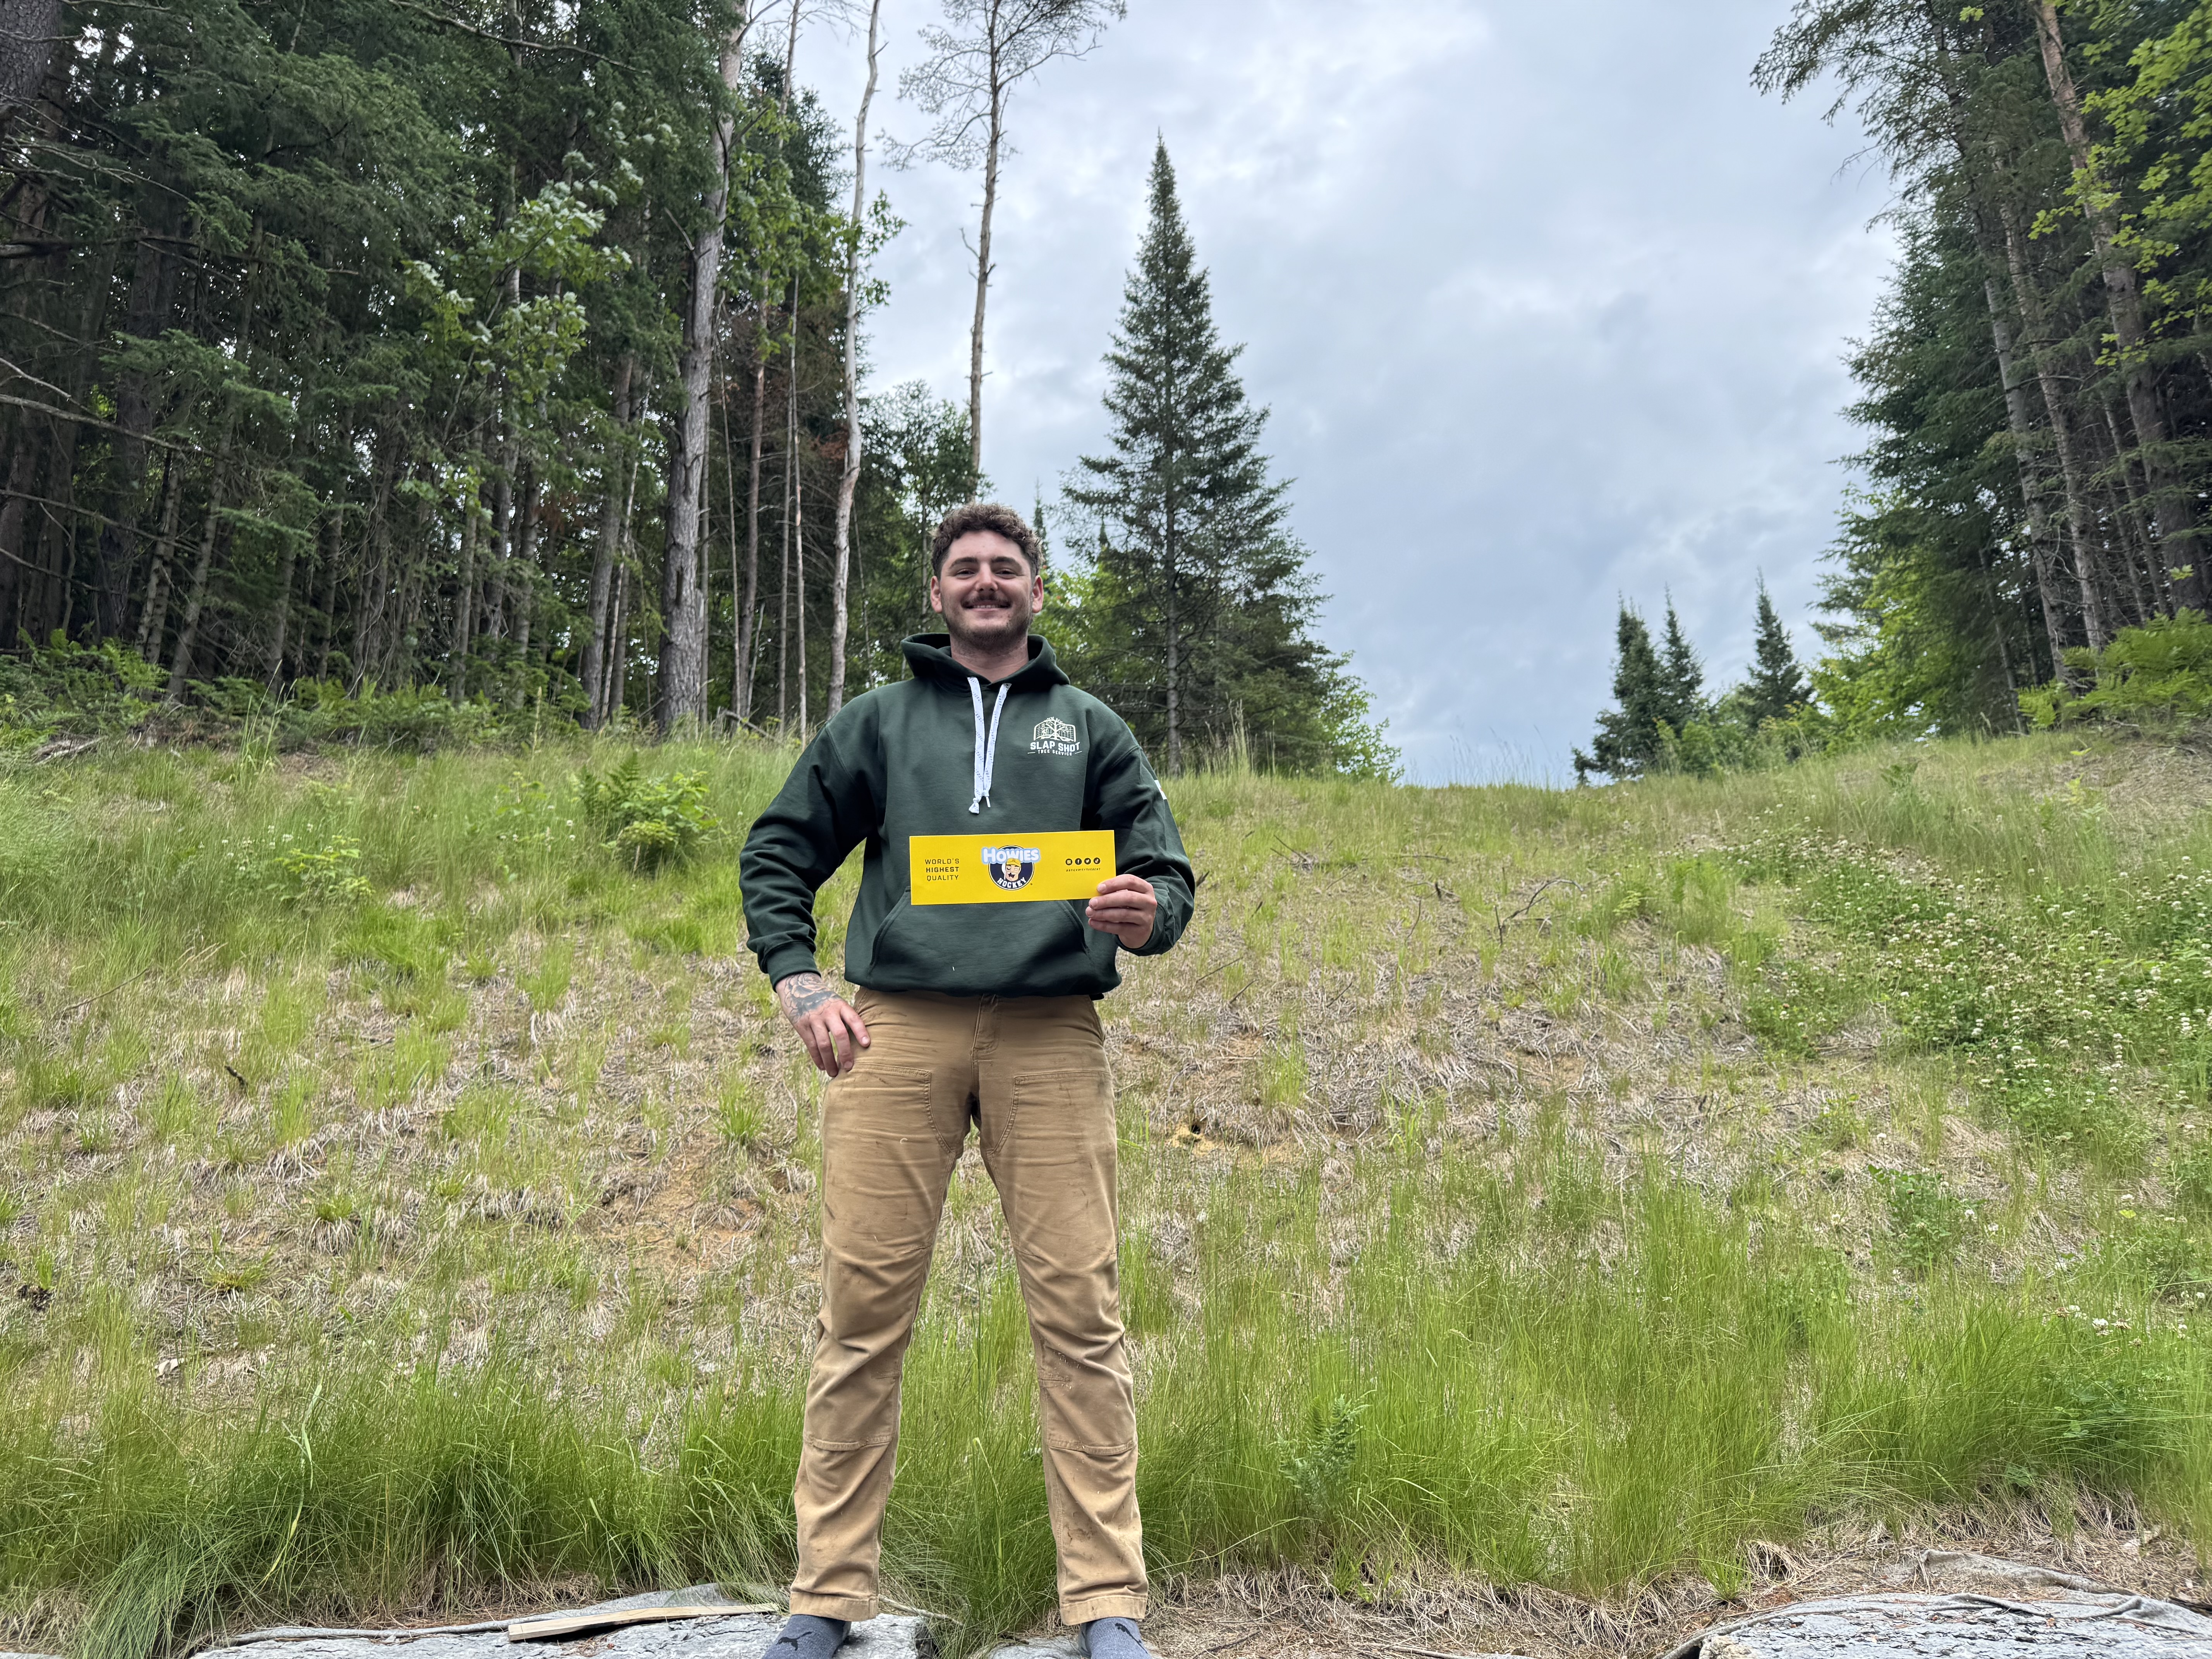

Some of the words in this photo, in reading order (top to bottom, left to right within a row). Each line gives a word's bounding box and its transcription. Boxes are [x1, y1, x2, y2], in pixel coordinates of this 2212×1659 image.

[1030, 740, 1055, 750] SLAP
[1058, 742, 1080, 752] SHOT
[982, 847, 1040, 864] HOWIES
[997, 877, 1027, 888] HOCKEY
